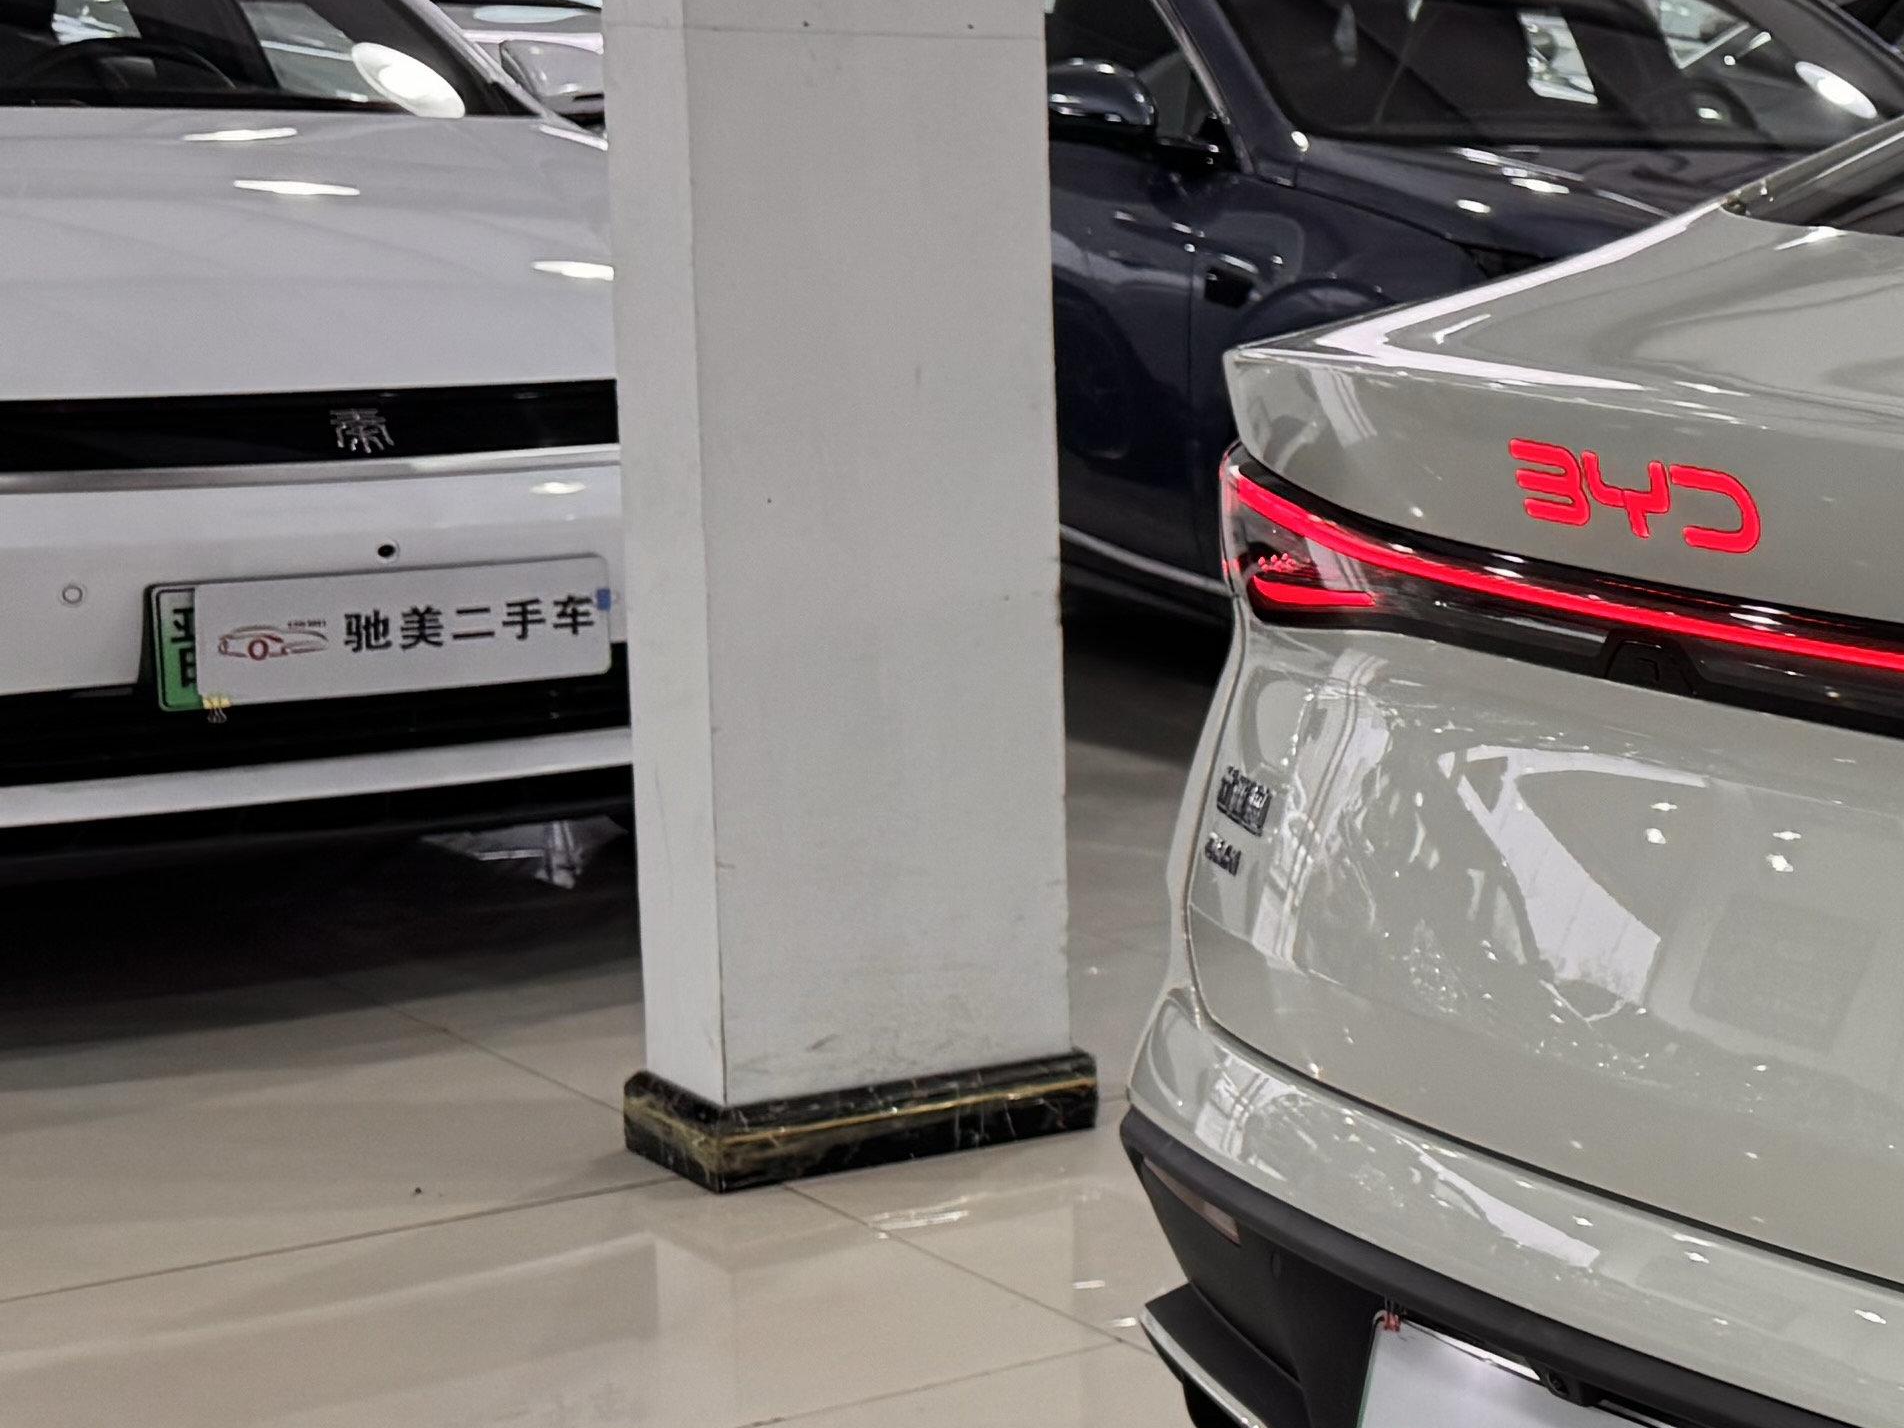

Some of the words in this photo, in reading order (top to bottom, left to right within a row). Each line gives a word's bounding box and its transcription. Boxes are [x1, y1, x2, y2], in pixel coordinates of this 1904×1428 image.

[1508, 437, 1761, 554] BYD
[344, 594, 595, 652] 驰美二手车
